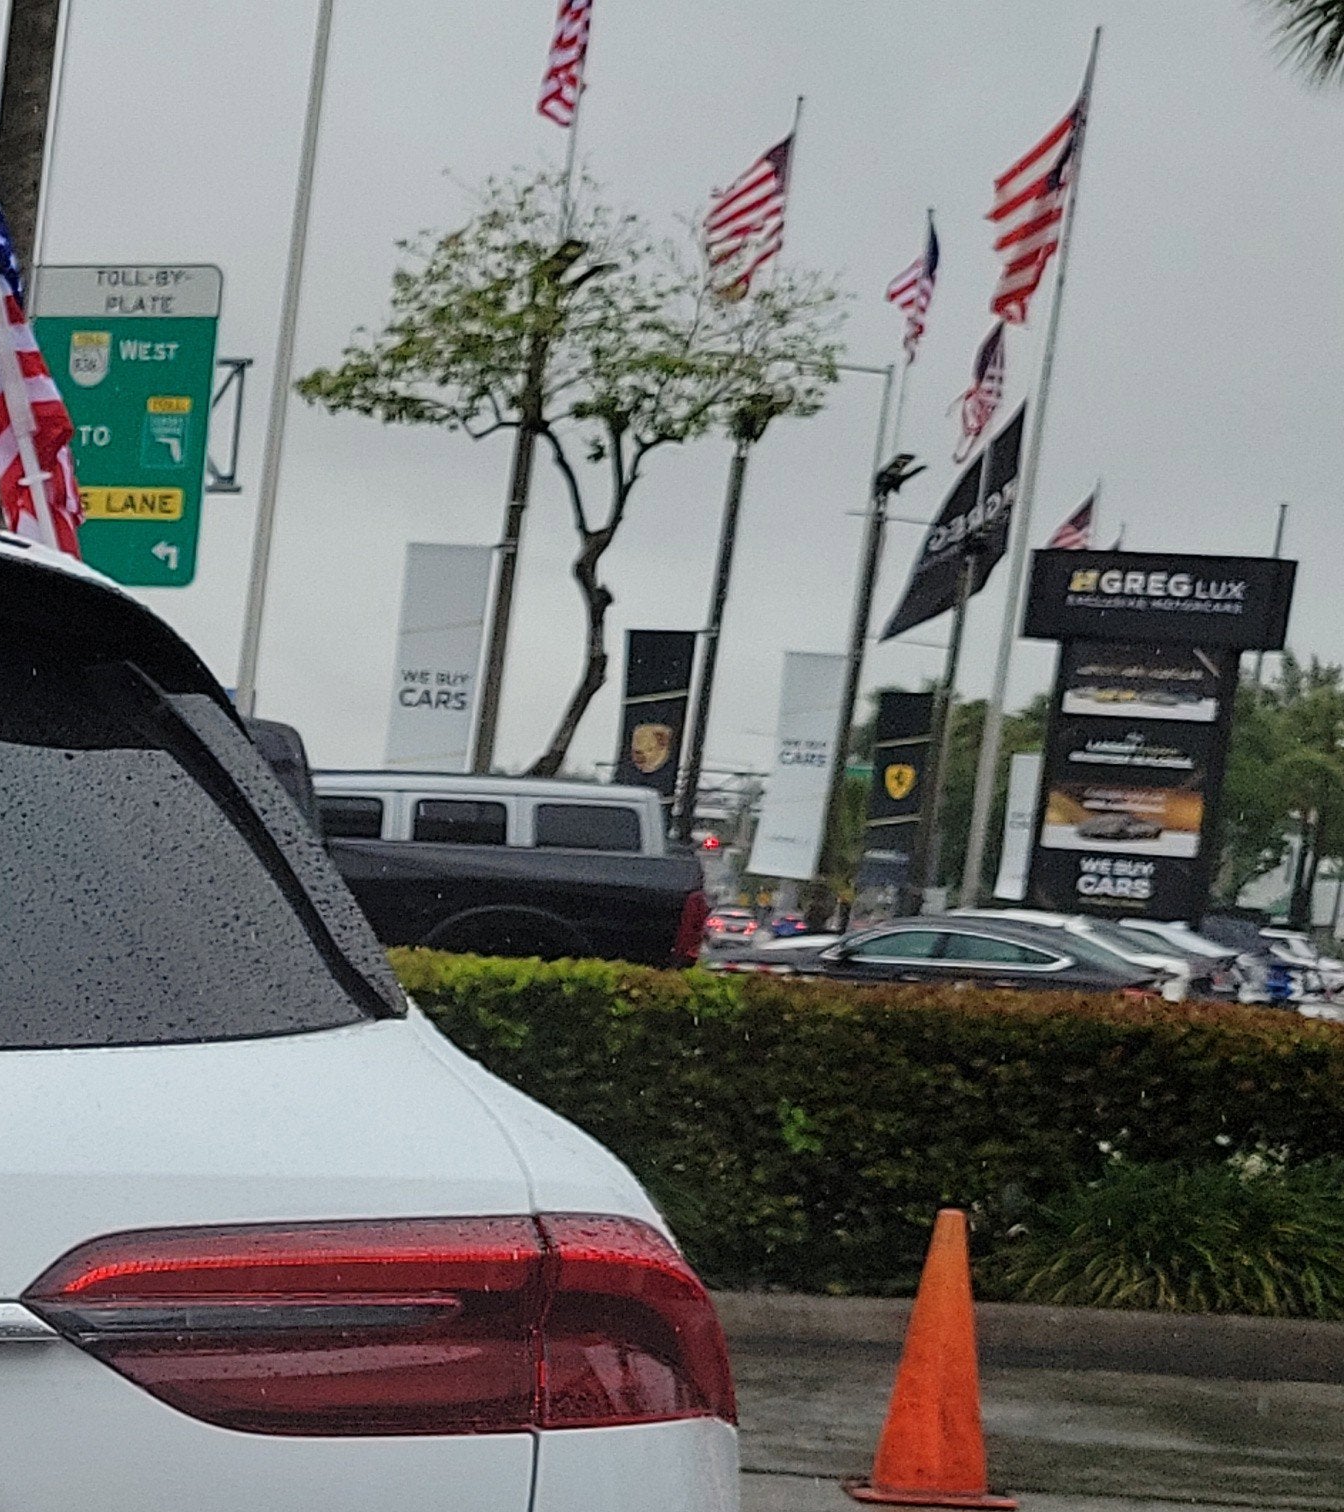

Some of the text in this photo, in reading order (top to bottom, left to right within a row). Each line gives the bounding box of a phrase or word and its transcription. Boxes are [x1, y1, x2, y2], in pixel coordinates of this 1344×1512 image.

[104, 295, 176, 314] PLATE
[119, 339, 180, 362] WEST
[78, 424, 111, 447] TO
[105, 493, 175, 515] LANE
[1098, 569, 1248, 600] GREG LUX
[400, 669, 431, 685] WE
[398, 688, 467, 711] CARS
[1078, 857, 1112, 874] WE
[1075, 873, 1153, 899] CARS
